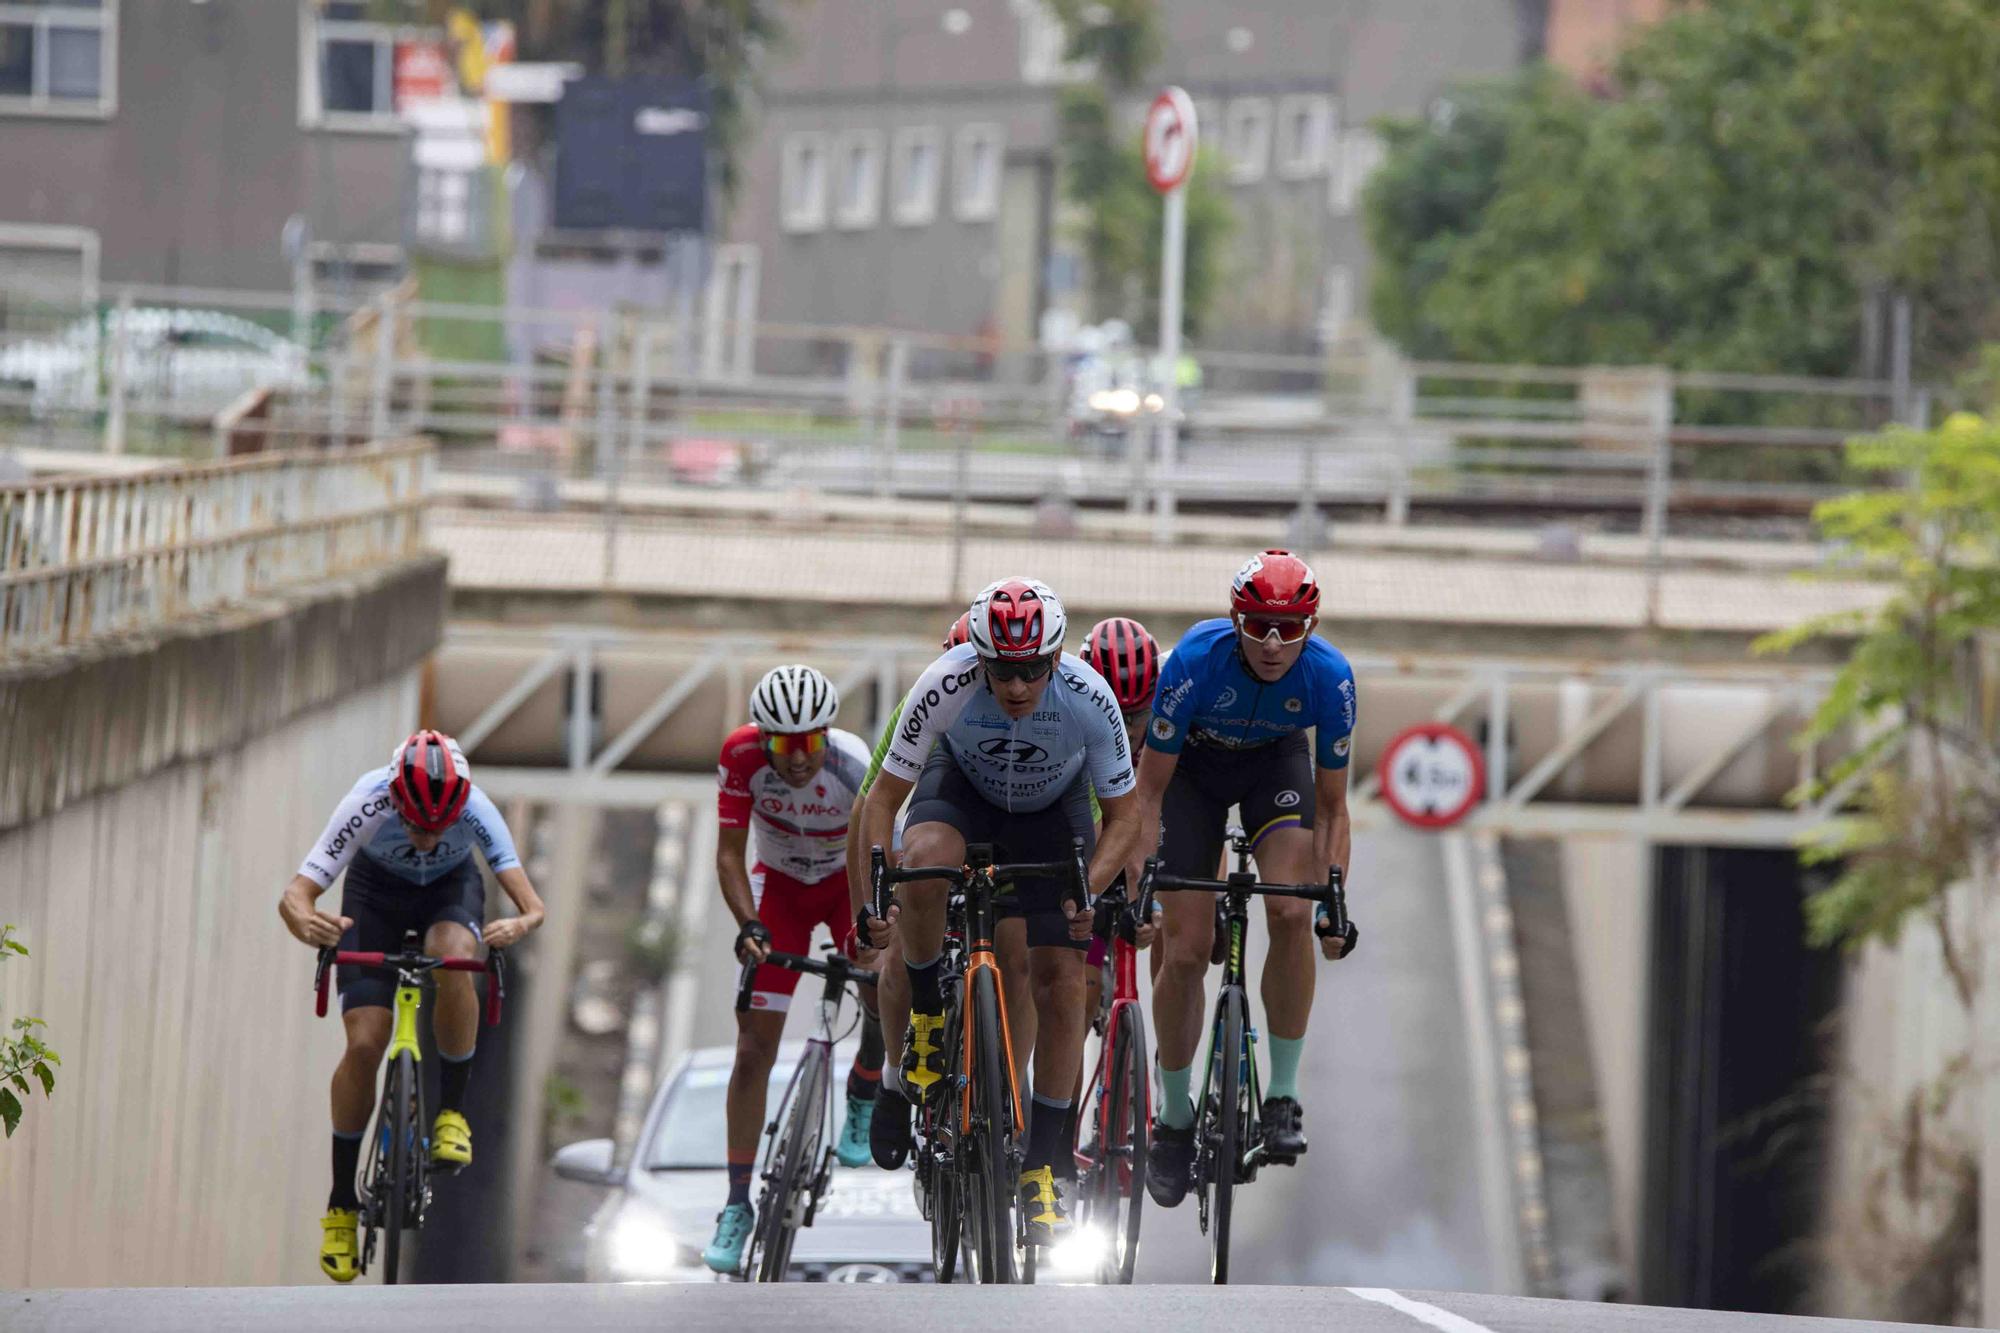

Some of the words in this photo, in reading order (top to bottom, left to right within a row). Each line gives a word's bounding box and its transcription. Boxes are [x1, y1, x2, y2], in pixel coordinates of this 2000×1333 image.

[901, 689, 941, 747] Koryo
[941, 666, 978, 695] Car
[1089, 690, 1127, 761] HYUNDAI
[325, 815, 363, 861] Koryo
